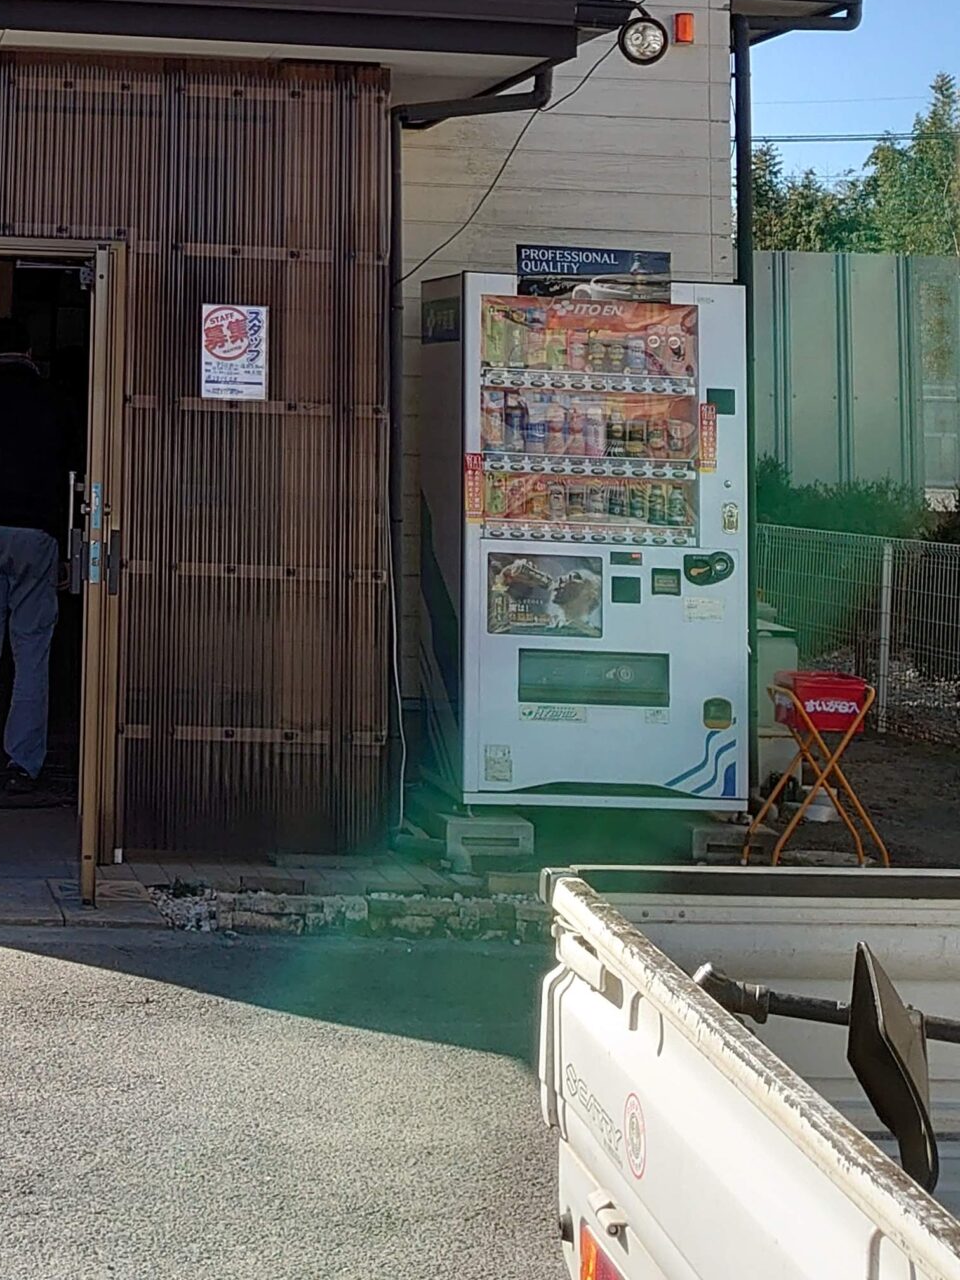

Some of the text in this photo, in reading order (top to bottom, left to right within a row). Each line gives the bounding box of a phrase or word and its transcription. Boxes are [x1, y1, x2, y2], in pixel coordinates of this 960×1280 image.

[521, 248, 619, 265] PROFESSIONAL
[521, 260, 580, 274] QUALITY
[574, 303, 624, 317] ITO EN
[209, 312, 235, 325] STAFF
[248, 311, 262, 362] スタッフ
